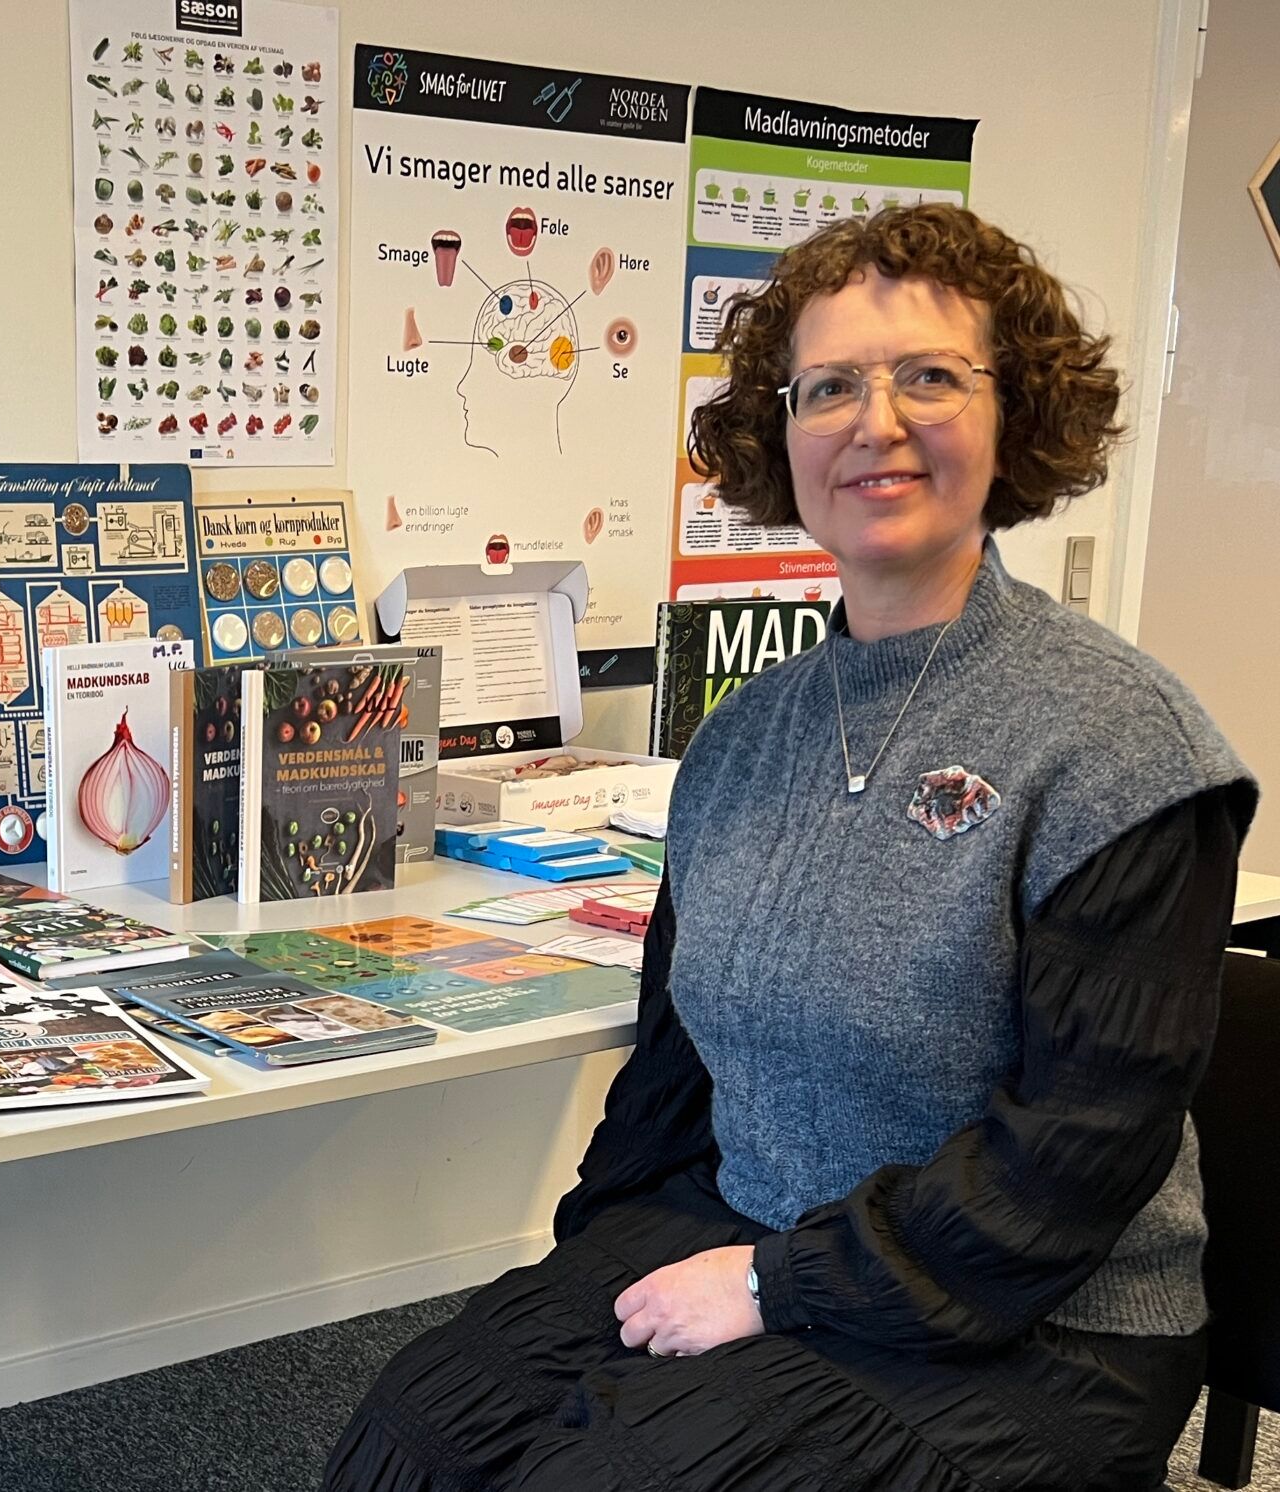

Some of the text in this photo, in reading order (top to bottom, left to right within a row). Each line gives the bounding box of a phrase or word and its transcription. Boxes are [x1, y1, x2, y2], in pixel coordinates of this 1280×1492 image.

[180, 0, 238, 20] sæson
[420, 71, 507, 102] SMAG for LIVET
[609, 88, 666, 109] NORDEA
[610, 100, 669, 122] FONDEN
[745, 107, 930, 149] Madlavningsmetoder
[365, 144, 674, 200] Vi smager med alle sanser
[807, 155, 869, 173] Kogemetoder
[540, 218, 569, 236] Føle
[378, 243, 429, 267] Smage
[619, 254, 650, 271] Høre
[387, 356, 429, 374] Lugte
[613, 363, 629, 378] Se
[61, 478, 75, 497] af
[610, 497, 629, 508] knas
[406, 505, 469, 520] en billion lugte
[609, 511, 631, 522] knæk
[203, 511, 340, 536] Dansk korn og kornprodukter
[405, 521, 454, 534] erindringer
[608, 526, 634, 538] smask
[279, 538, 296, 547] Rug
[327, 535, 342, 544] Byg
[513, 539, 564, 551] mundfølelse
[779, 561, 837, 575] Stivnemetod
[706, 608, 826, 674] MAD
[67, 672, 150, 690] MADKUNDSKAB
[67, 690, 103, 700] EN TEORIBOG
[401, 740, 424, 762] ING
[460, 735, 476, 751] Dag
[278, 745, 384, 765] VERDENSMÅL &
[203, 764, 240, 781] MADKU
[276, 763, 385, 782] MADKUNDSKAB
[303, 784, 318, 792] om
[531, 795, 591, 815] Smagens Dag
[21, 919, 85, 935] MIT
[176, 987, 284, 1004] EKSPERIMENTER
